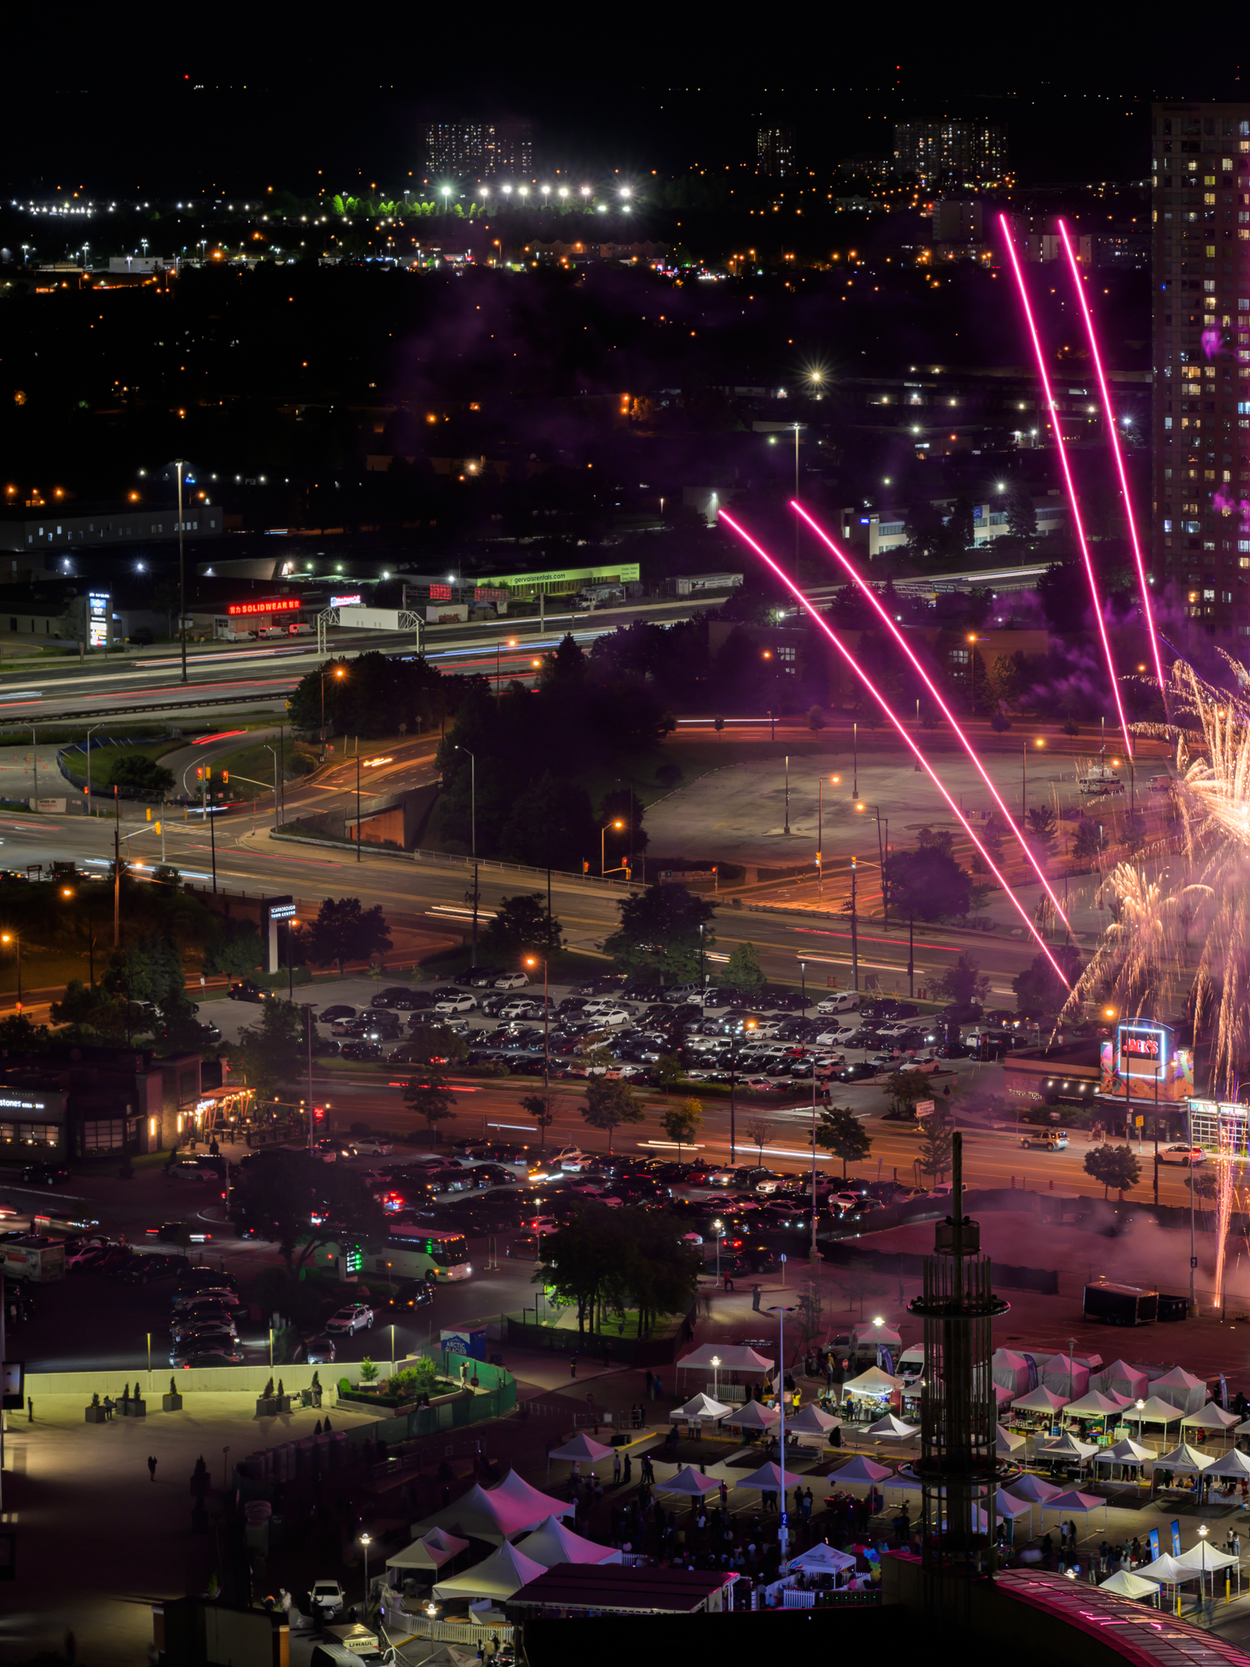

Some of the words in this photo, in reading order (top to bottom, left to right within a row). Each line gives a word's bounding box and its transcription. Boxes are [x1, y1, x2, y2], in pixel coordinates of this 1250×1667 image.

[514, 572, 566, 584] gervaisrentals.com
[242, 601, 287, 613] SOLIDWEAR
[1122, 1037, 1159, 1055] JACK'S
[446, 1340, 466, 1349] ARCTIC
[782, 1513, 787, 1524] 2
